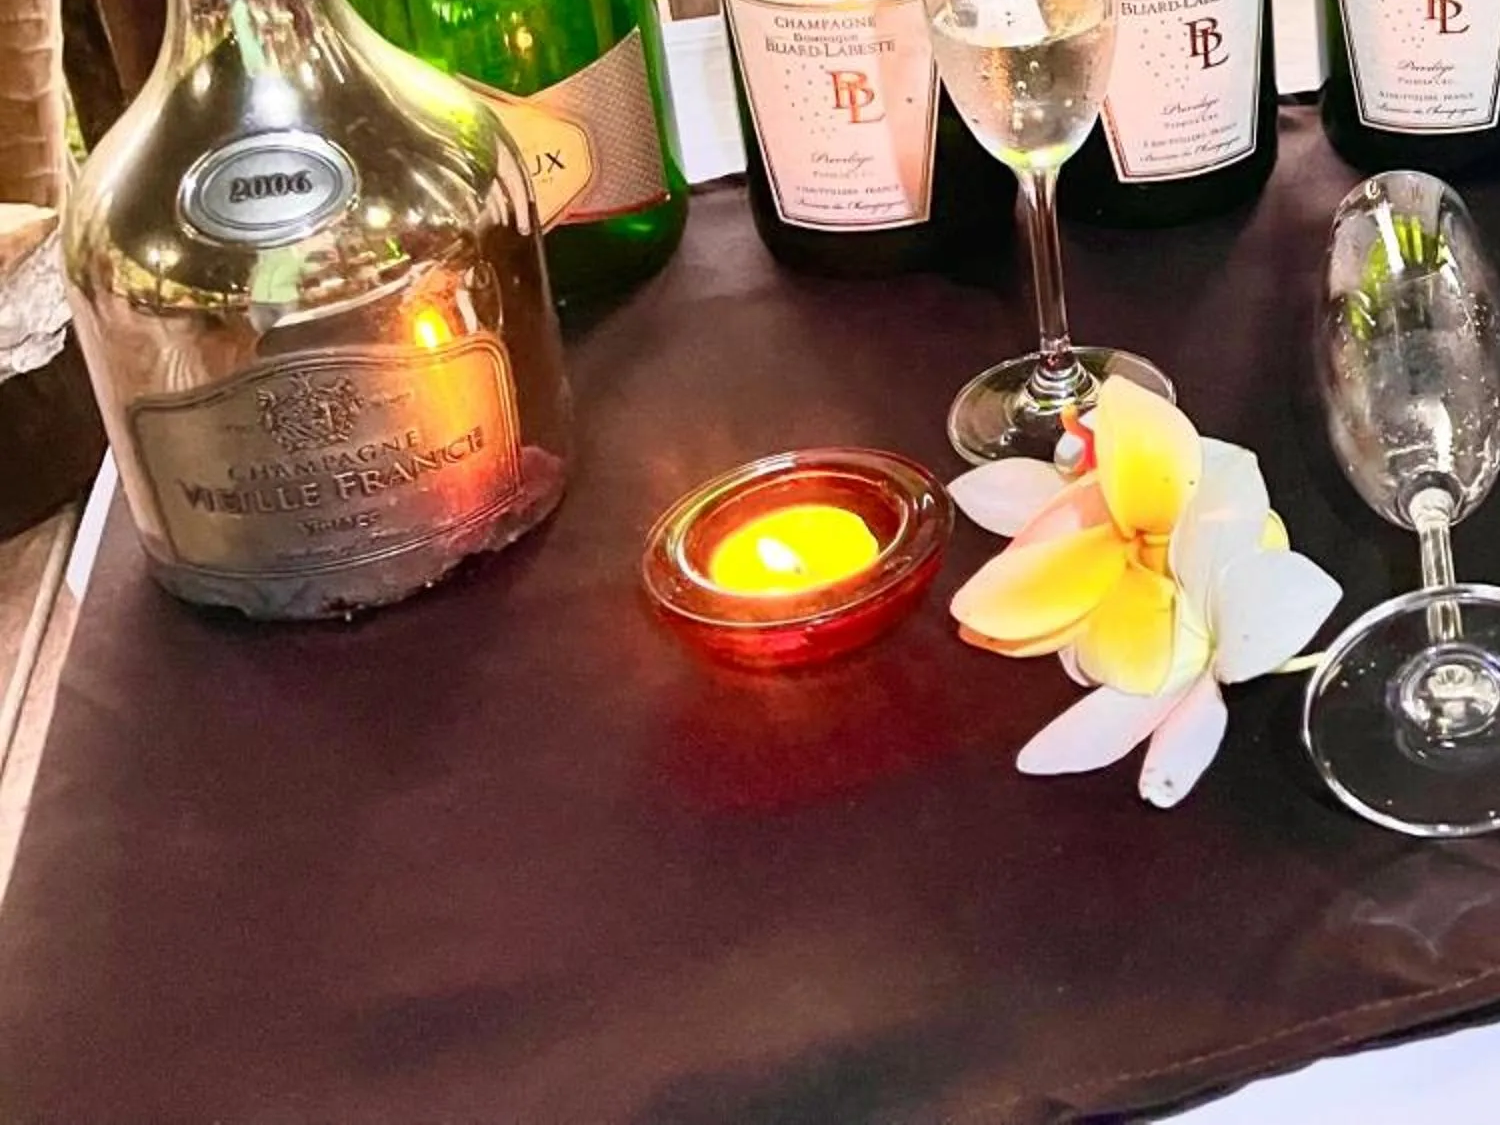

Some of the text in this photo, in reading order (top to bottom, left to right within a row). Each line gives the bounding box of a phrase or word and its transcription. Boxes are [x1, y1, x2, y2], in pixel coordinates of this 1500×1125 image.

[774, 15, 877, 31] CHAMPAGNE
[229, 170, 313, 204] 2006
[228, 429, 420, 482] CHAMPAGNE
[332, 426, 485, 500] FRANCE
